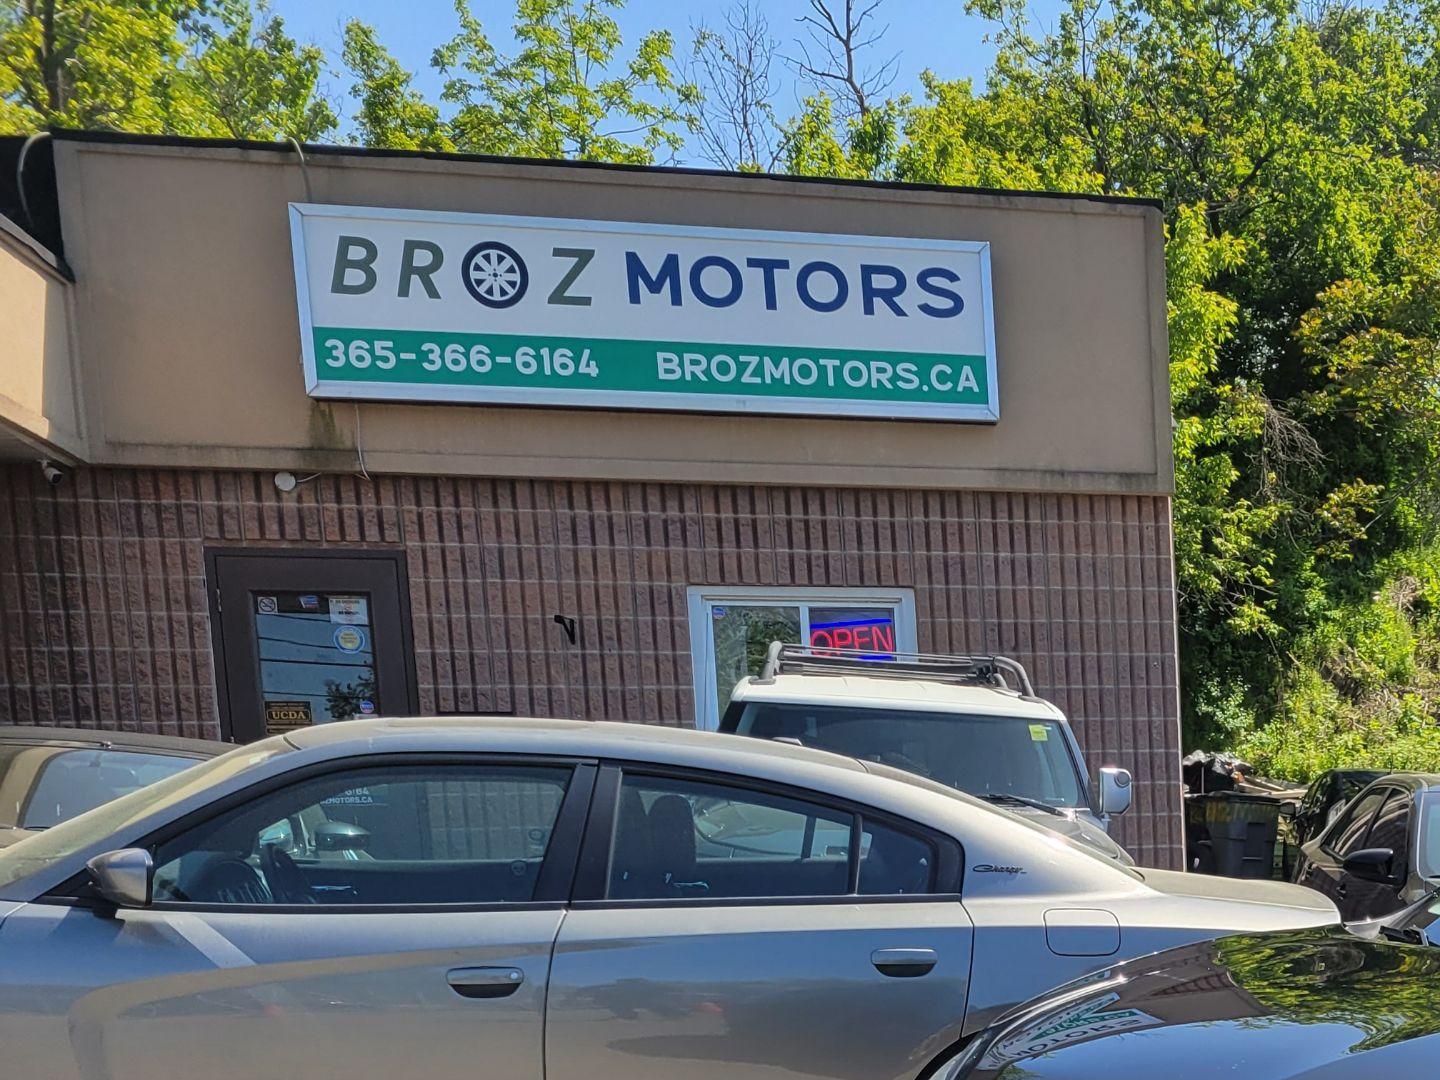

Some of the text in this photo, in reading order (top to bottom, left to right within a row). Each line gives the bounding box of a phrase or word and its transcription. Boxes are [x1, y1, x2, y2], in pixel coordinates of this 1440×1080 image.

[626, 251, 966, 319] MOTORS
[323, 338, 980, 393] 365-366-6164 BROZMOTORS.CA
[810, 626, 895, 656] OPEN
[271, 711, 306, 720] UCDA
